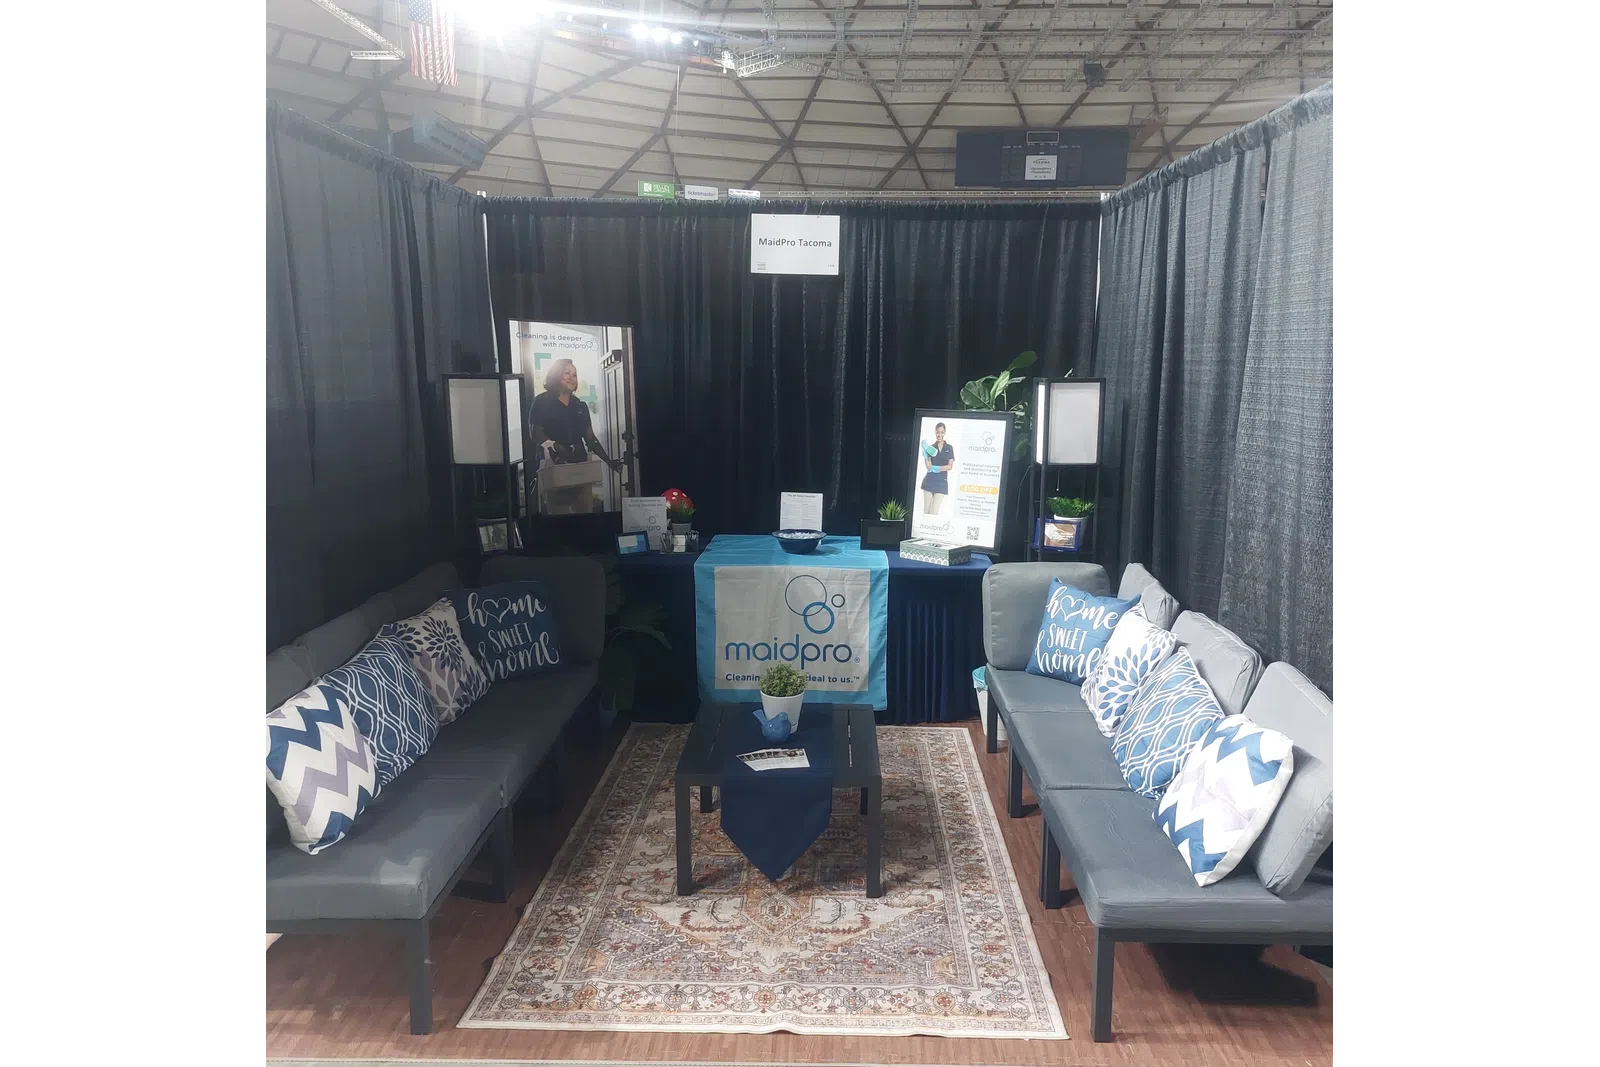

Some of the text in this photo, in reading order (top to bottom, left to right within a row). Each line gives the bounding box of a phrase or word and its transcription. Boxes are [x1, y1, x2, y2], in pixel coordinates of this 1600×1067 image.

[758, 238, 832, 247] MaidPro Tacoma
[516, 331, 548, 340] Cleaning
[558, 334, 583, 342] deeper
[559, 342, 587, 350] maidpro
[968, 444, 996, 454] maidpro
[919, 524, 944, 532] maidpro
[488, 622, 533, 654] SWEET
[1046, 622, 1089, 653] SWEET
[725, 673, 761, 682] Cleanin
[828, 675, 838, 683] to
